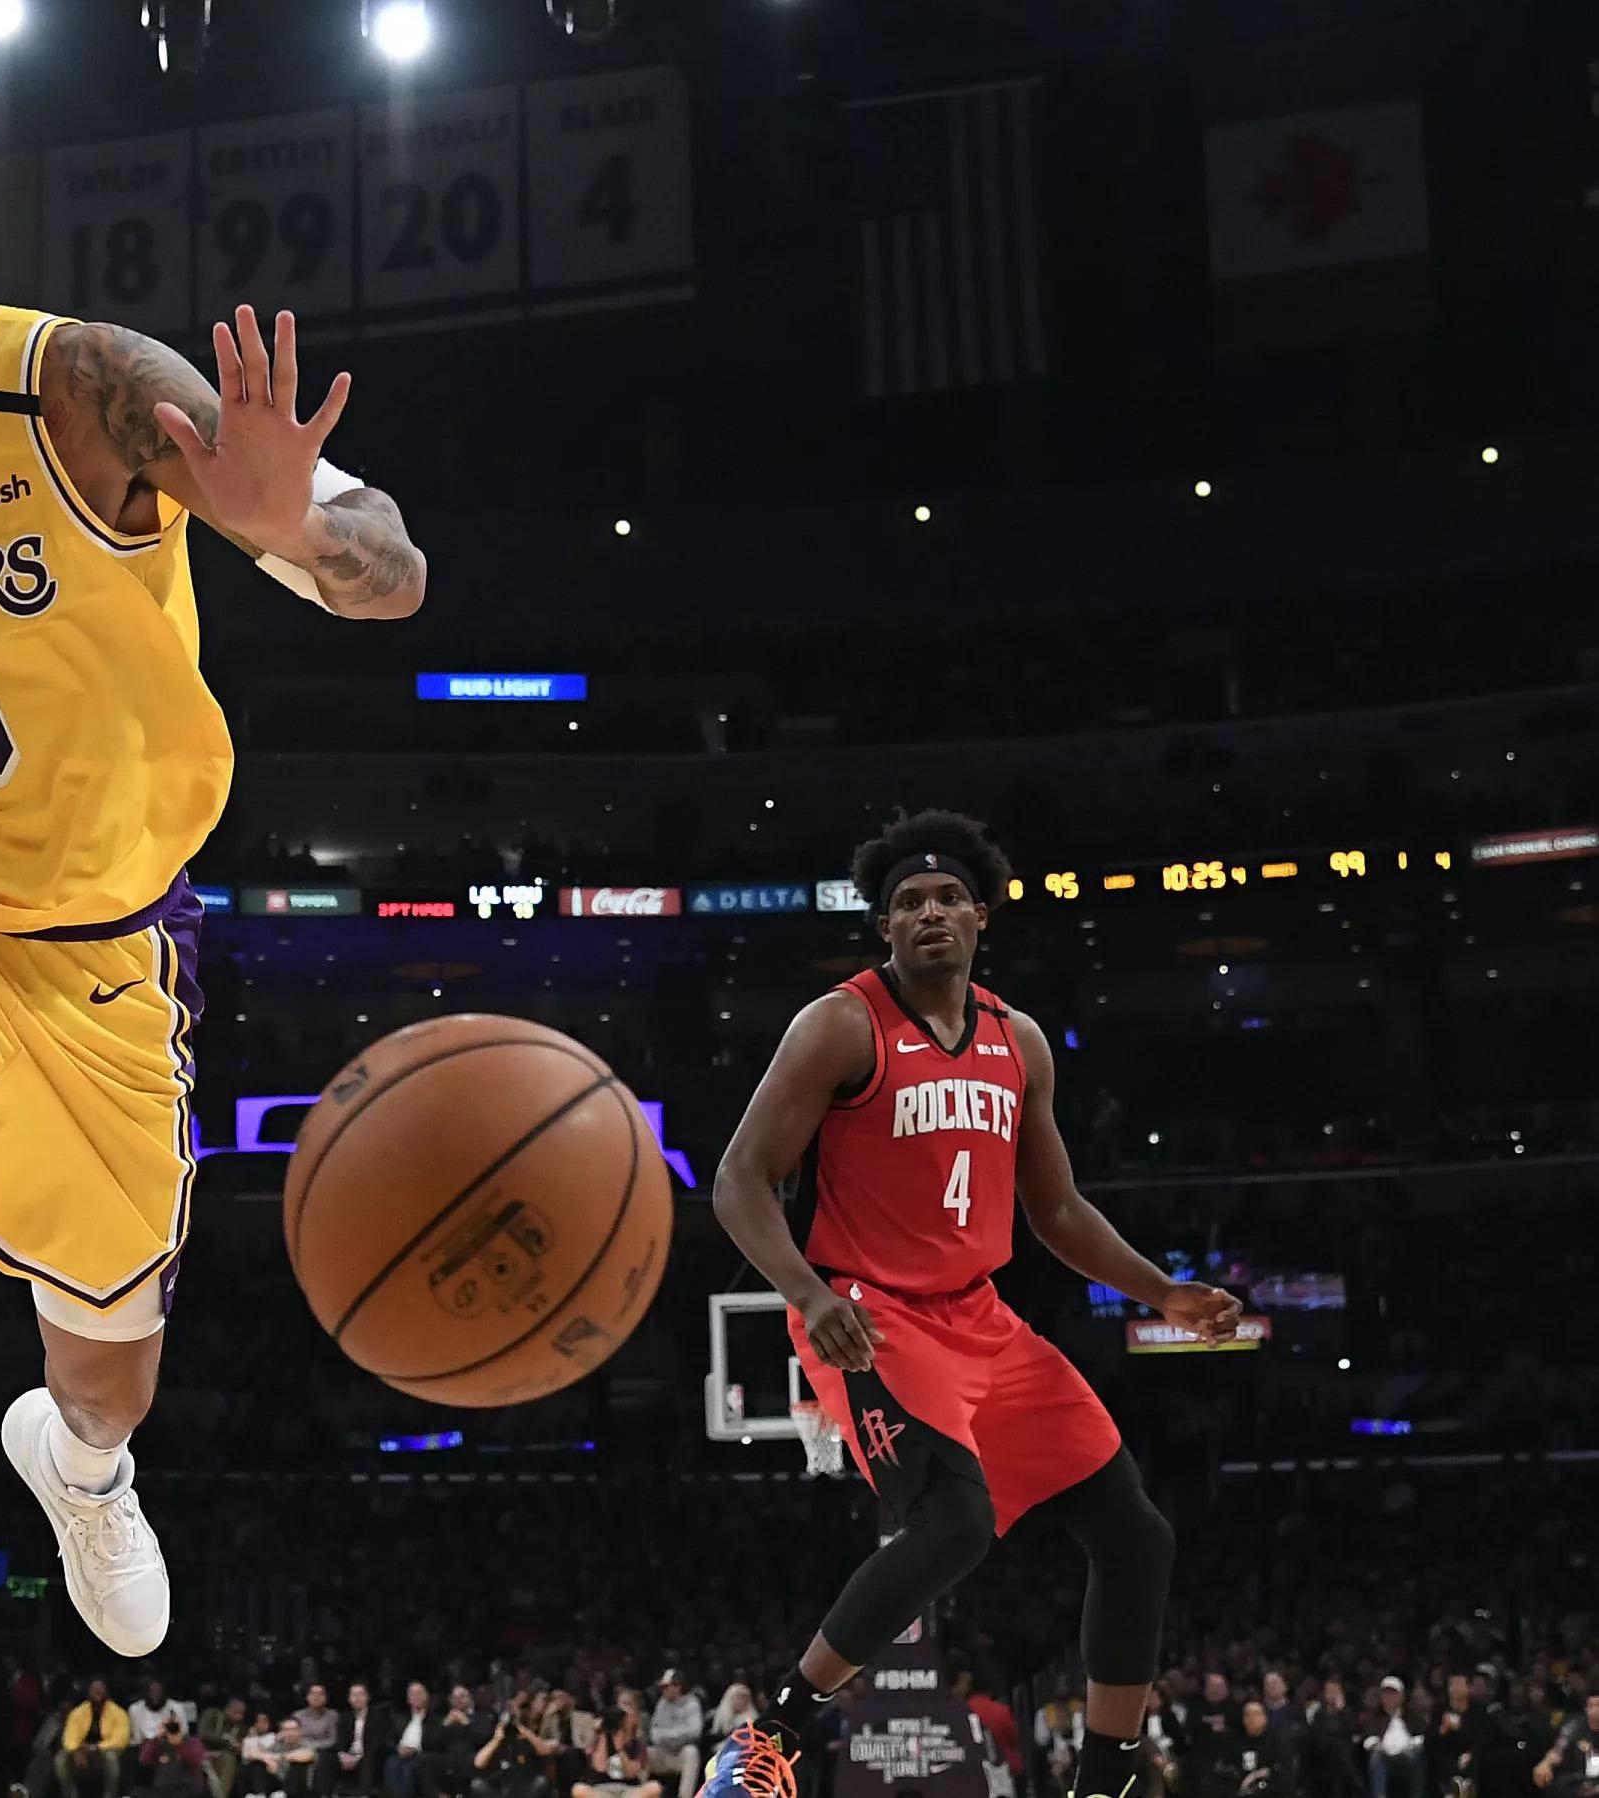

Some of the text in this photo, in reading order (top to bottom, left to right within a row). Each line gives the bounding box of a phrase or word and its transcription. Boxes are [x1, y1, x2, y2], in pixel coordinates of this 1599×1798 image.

[379, 172, 503, 272] 20
[579, 153, 634, 246] 4
[68, 217, 162, 308] 18
[215, 192, 334, 290] 99
[719, 889, 809, 910] DELTA
[1045, 872, 1079, 898] 95
[1330, 851, 1365, 877] 99
[892, 1078, 1017, 1143] ROCKETS
[943, 1150, 971, 1227] 4
